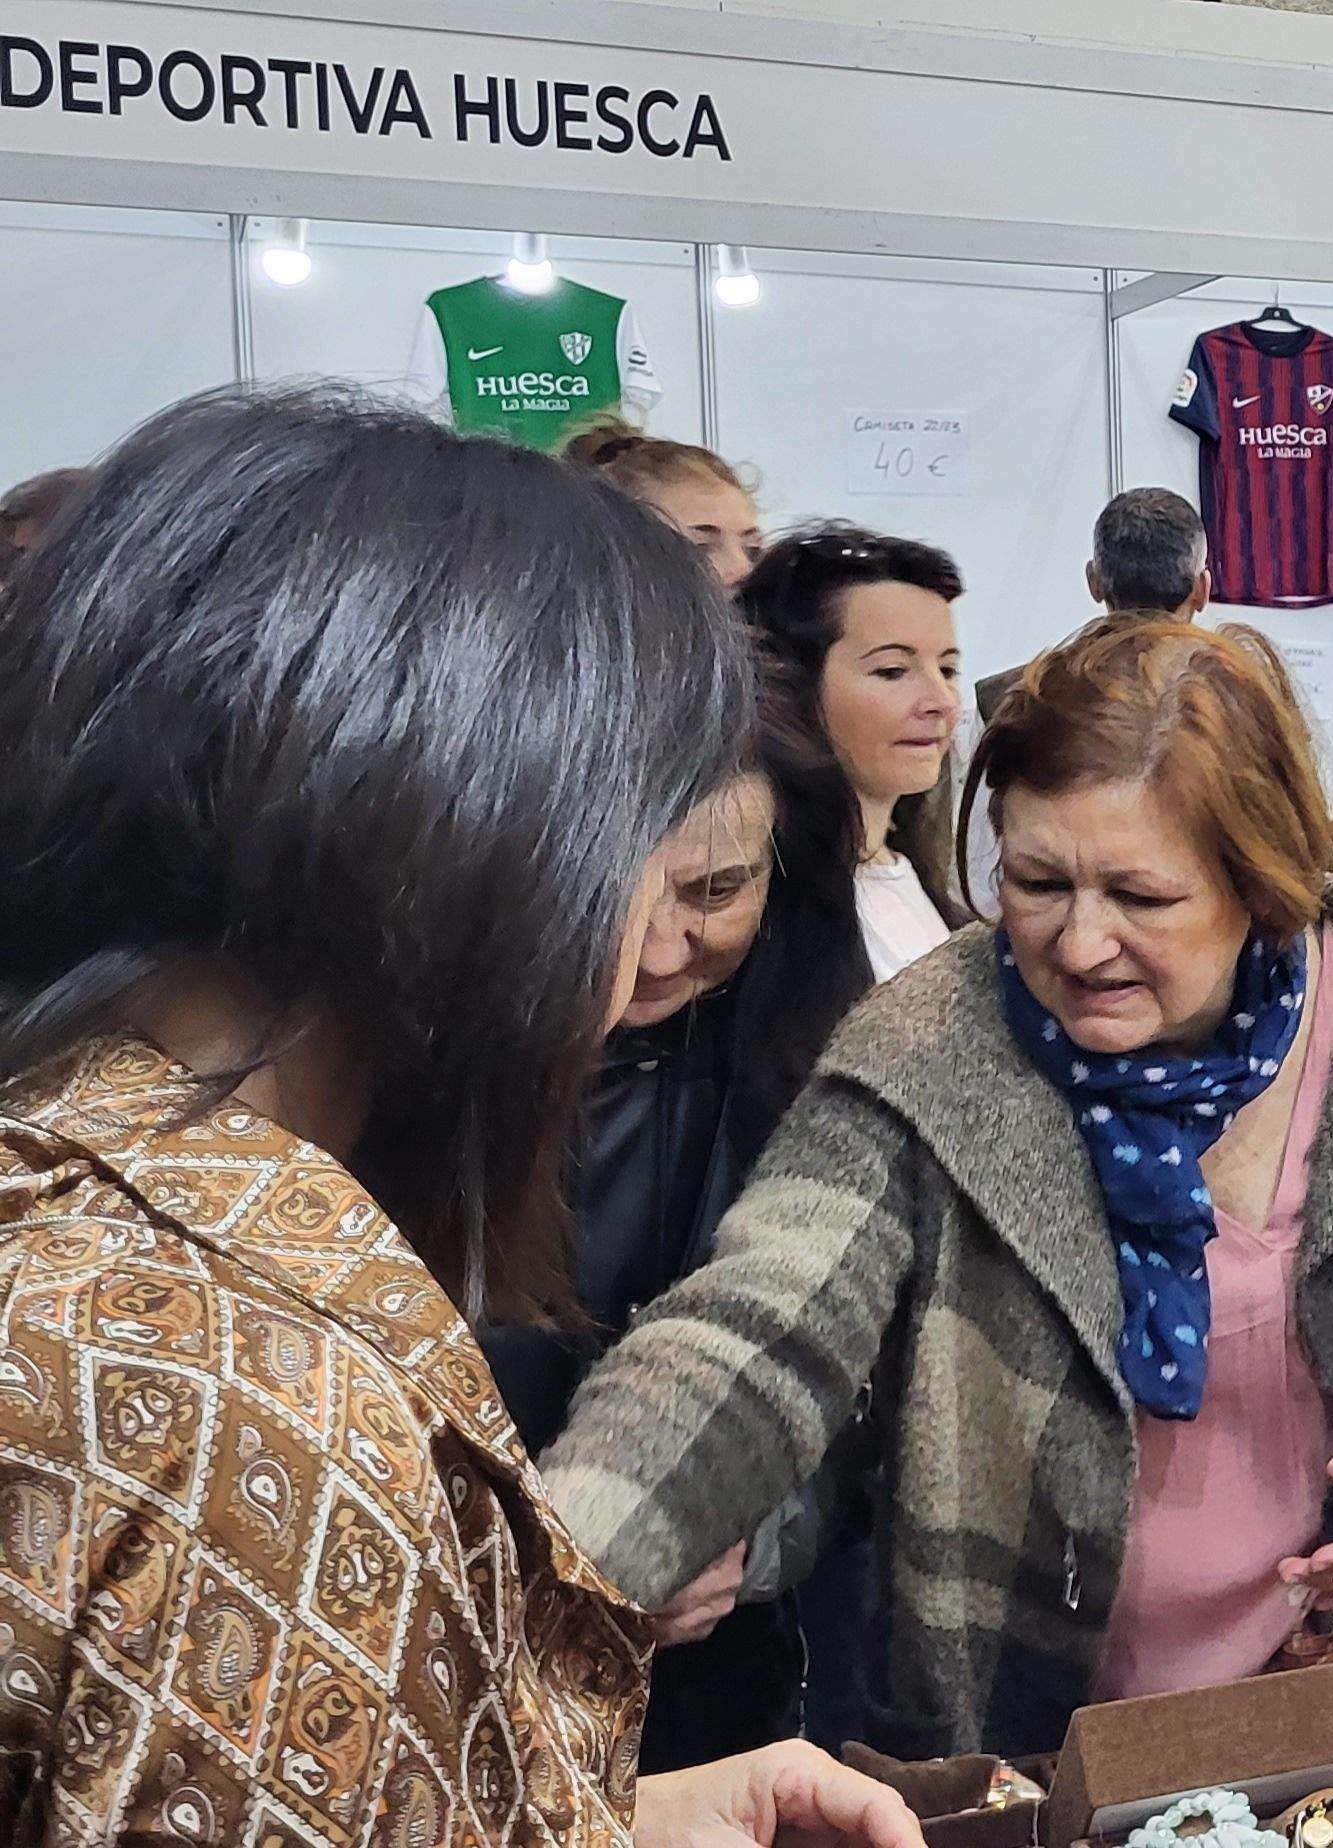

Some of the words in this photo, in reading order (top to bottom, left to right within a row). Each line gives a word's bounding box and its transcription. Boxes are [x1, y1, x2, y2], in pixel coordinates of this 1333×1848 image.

[0, 35, 432, 139] DEPORTIVA
[454, 74, 732, 161] HUESCA
[874, 442, 914, 478] 40
